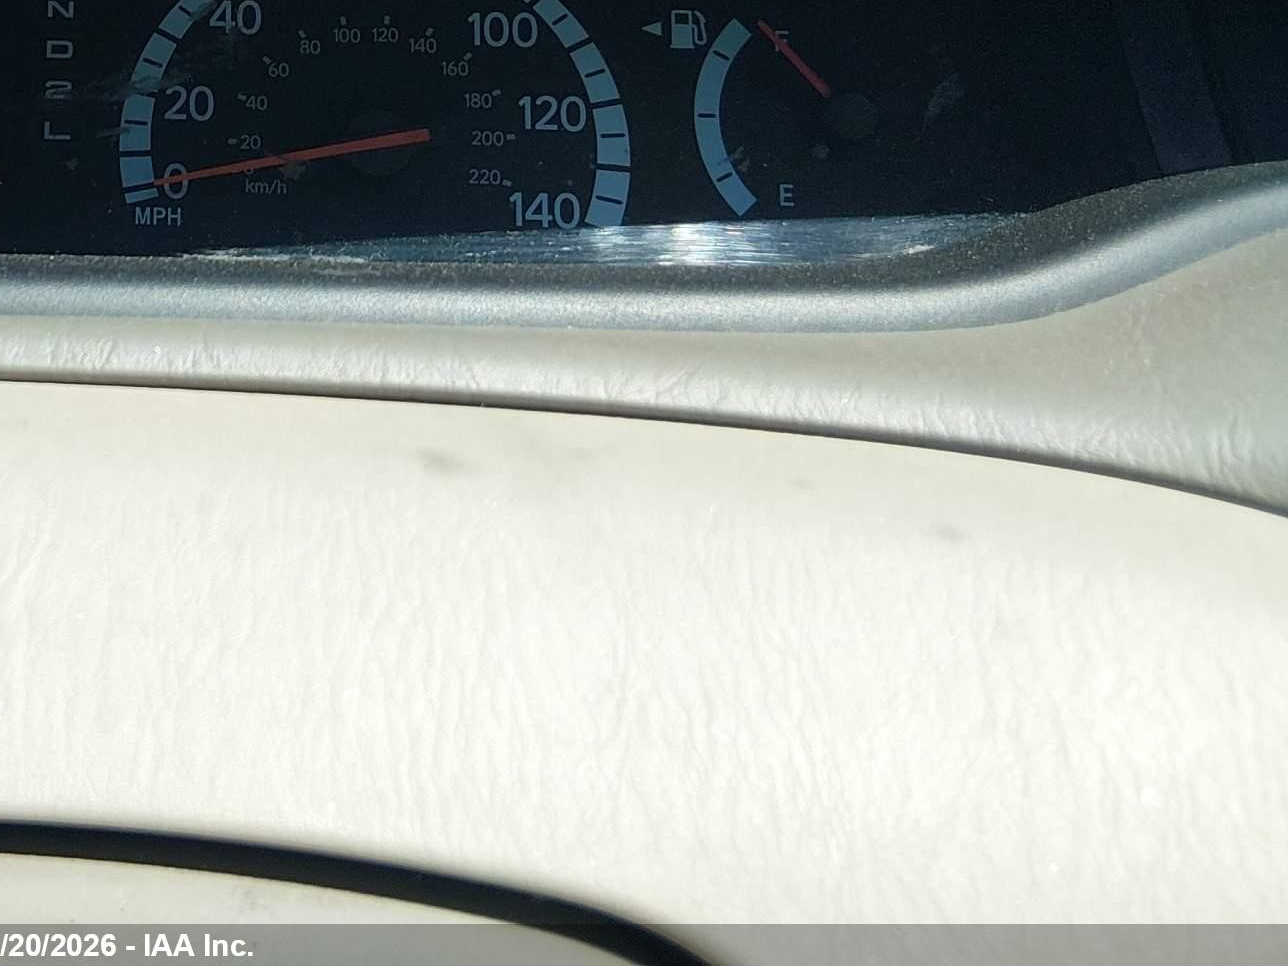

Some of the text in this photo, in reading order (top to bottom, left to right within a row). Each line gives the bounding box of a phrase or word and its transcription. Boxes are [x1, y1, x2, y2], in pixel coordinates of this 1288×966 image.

[48, 1, 74, 18] N
[208, 0, 262, 35] 40
[333, 29, 360, 42] 100
[372, 28, 398, 42] 120
[468, 11, 538, 48] 100
[47, 41, 73, 58] D
[300, 40, 320, 54] 80
[409, 38, 436, 53] 140
[268, 60, 289, 77] 60
[441, 59, 468, 76] 160
[46, 81, 72, 99] 2
[165, 86, 213, 121] 20
[245, 96, 267, 110] 40
[464, 92, 493, 108] 180
[519, 96, 586, 131] 120
[44, 122, 71, 140] L
[472, 131, 503, 146] 200
[240, 135, 260, 149] 20
[162, 163, 186, 200] 0
[469, 169, 500, 184] 220
[246, 179, 286, 194] km/h
[780, 184, 794, 206] E
[136, 207, 181, 226] MPH
[508, 192, 581, 231] 140
